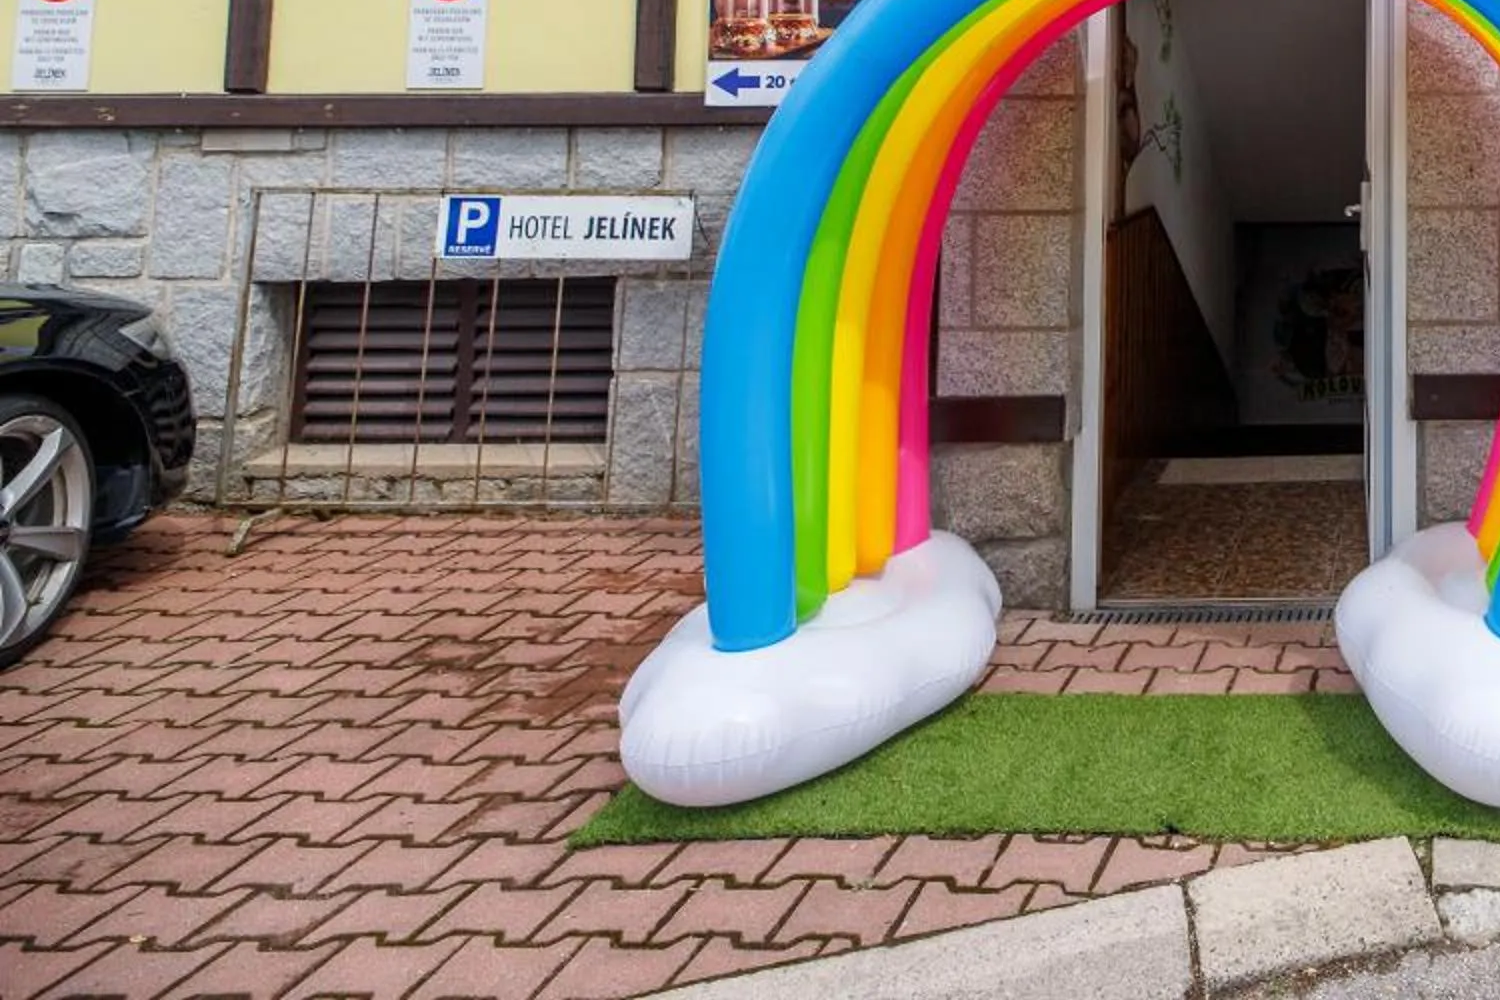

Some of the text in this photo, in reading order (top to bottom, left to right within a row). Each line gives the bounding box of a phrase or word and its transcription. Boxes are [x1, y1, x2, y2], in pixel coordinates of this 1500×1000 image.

[766, 76, 785, 88] 20
[457, 201, 490, 244] P
[509, 212, 676, 241] HOTEL JELÍNEK
